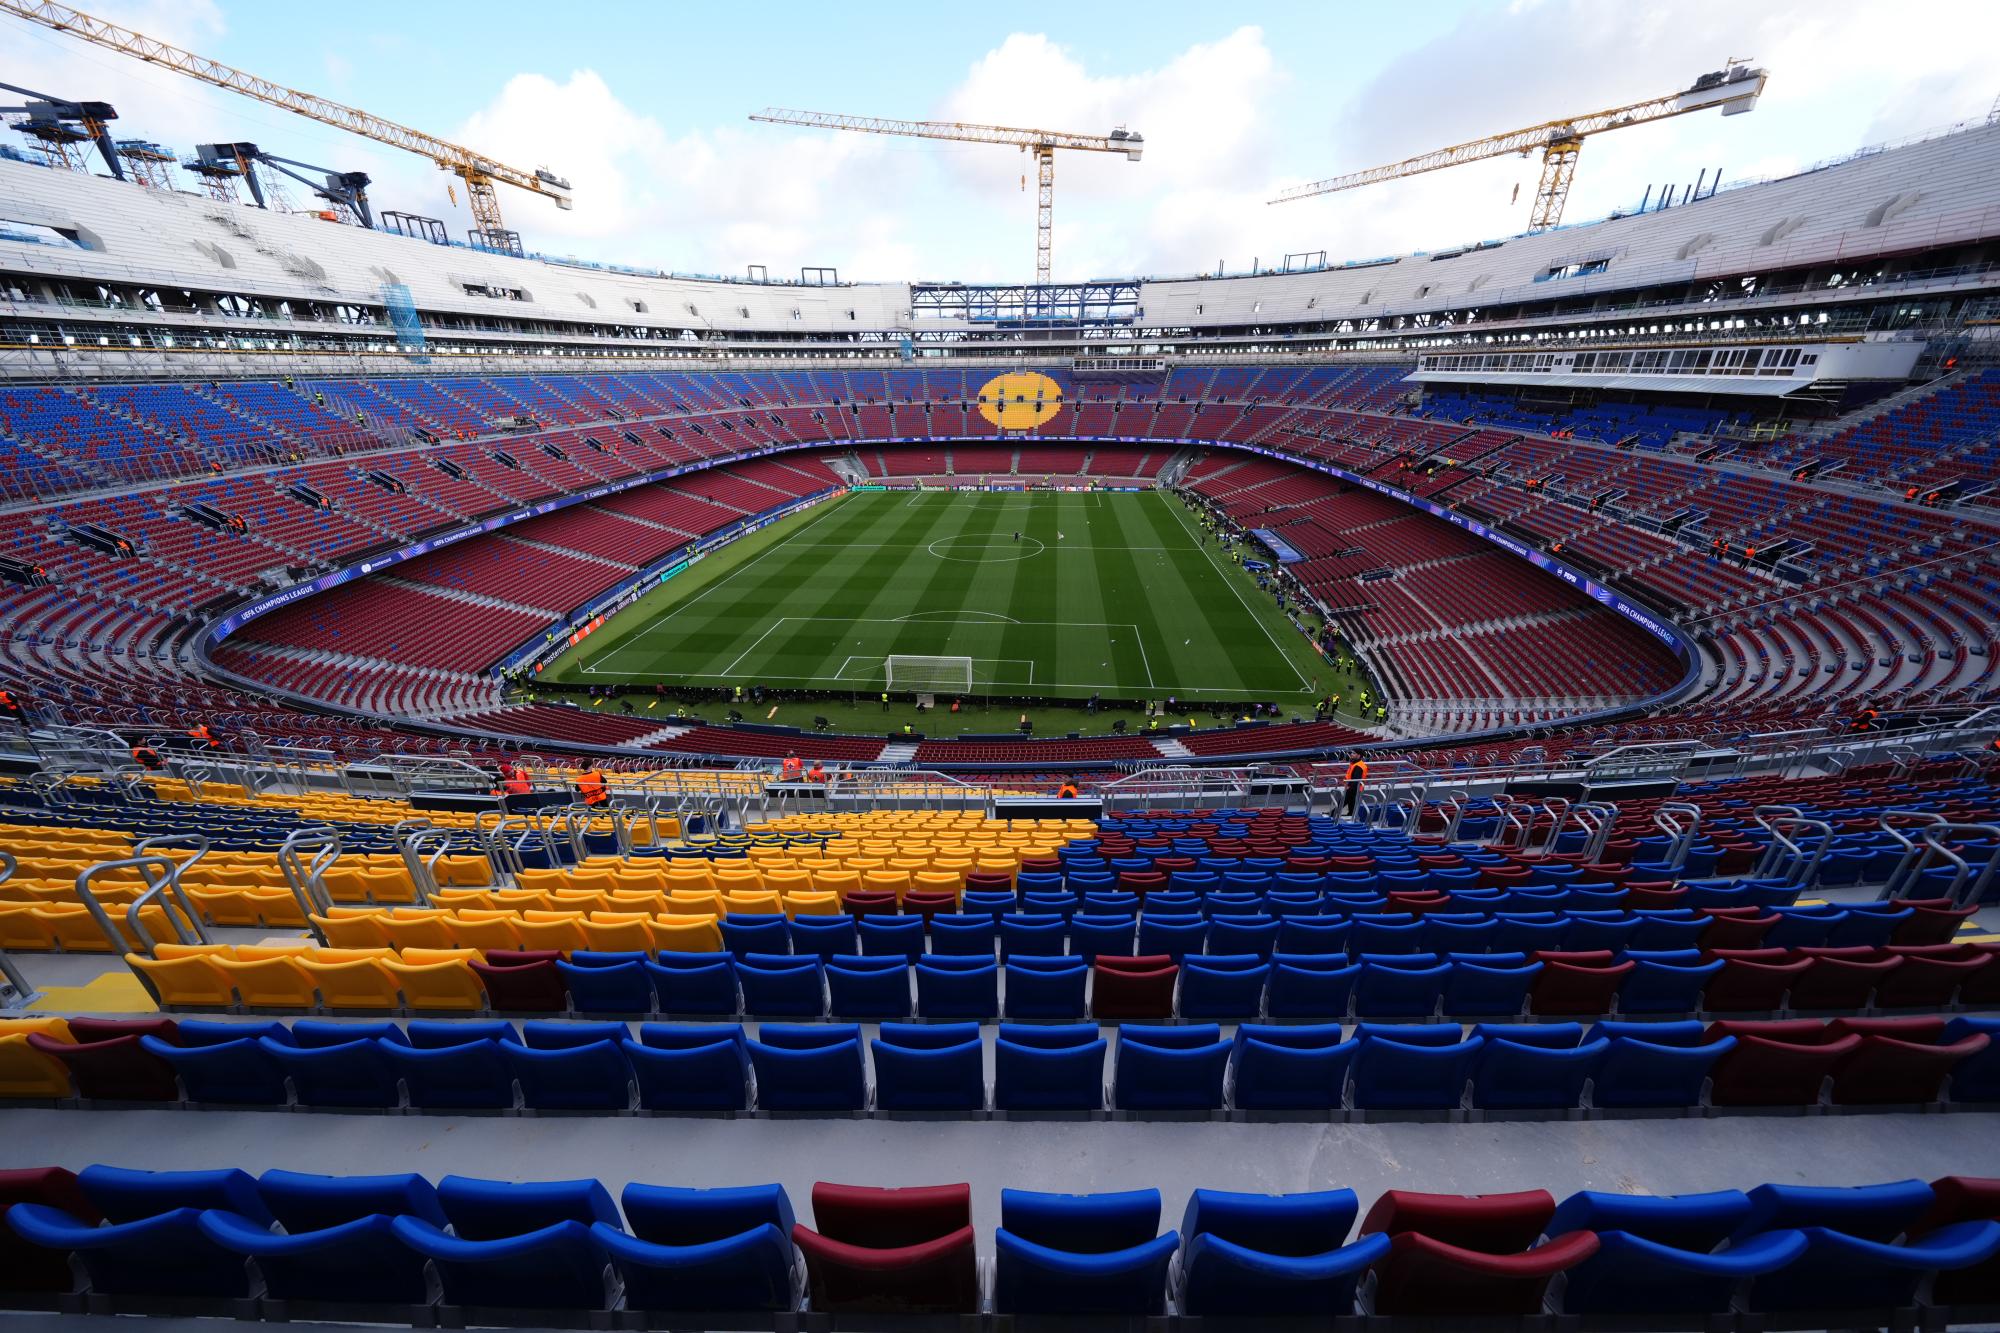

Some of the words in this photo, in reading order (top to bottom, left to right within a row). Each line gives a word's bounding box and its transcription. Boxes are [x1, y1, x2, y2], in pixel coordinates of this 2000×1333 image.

[444, 531, 467, 544] CHAMPIONS
[1563, 572, 1577, 583] PEPSI
[641, 578, 661, 595] crypto.com
[241, 609, 255, 620] UEFA
[254, 595, 289, 613] CHAMPIONS
[289, 585, 314, 601] LEAGUE
[604, 607, 617, 620] QATAR
[1617, 602, 1630, 614] UEFA
[1629, 609, 1659, 633] CHAMPIONS
[1658, 627, 1675, 646] LEAGUE
[542, 641, 570, 667] mastercard
